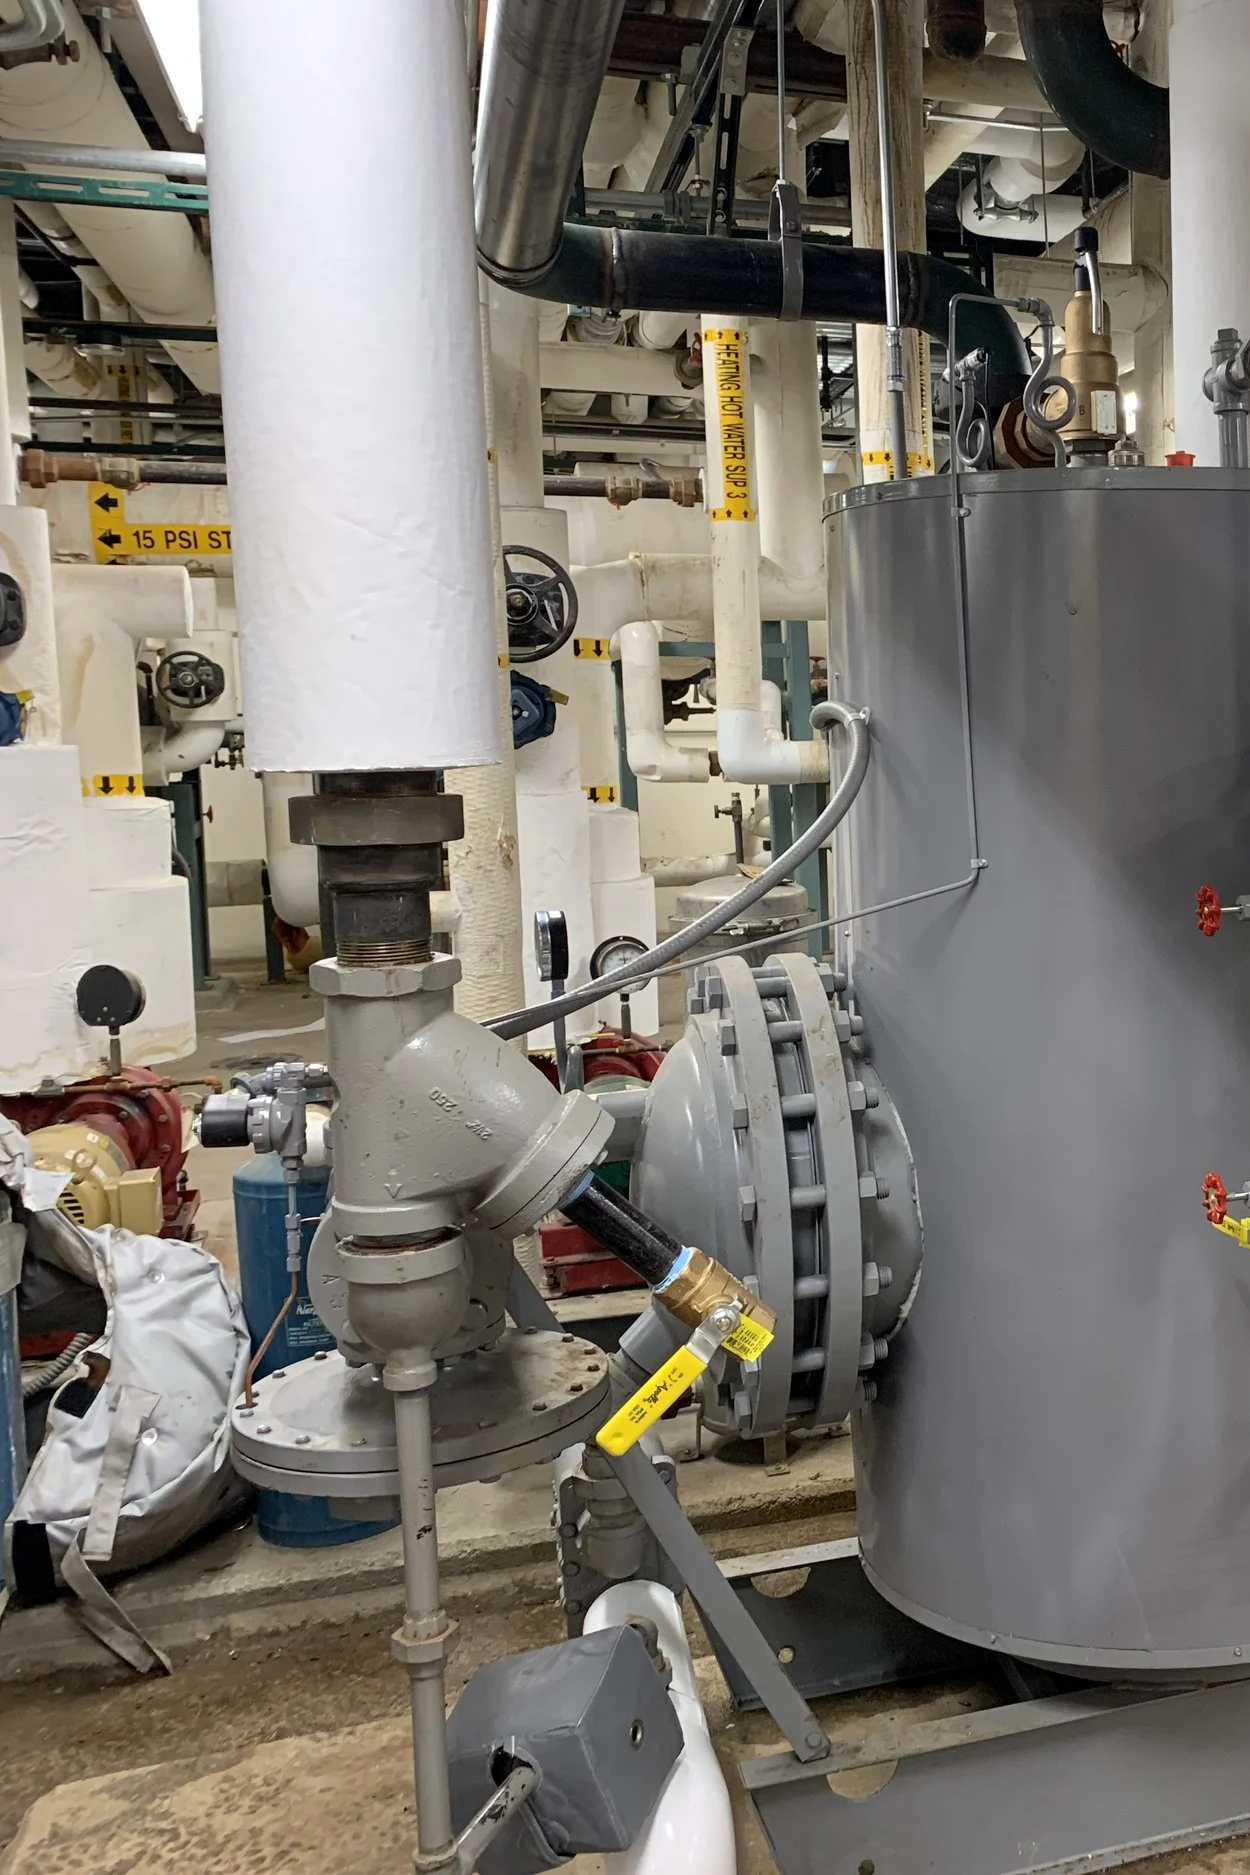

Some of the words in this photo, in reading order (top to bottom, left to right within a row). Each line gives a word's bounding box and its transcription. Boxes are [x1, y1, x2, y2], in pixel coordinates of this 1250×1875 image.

[717, 344, 741, 390] HEATING
[720, 396, 743, 418] HOT
[722, 423, 745, 460] WATER
[725, 464, 747, 488] SUP
[726, 491, 747, 499] 3
[132, 530, 155, 549] 15
[164, 530, 198, 549] PSI
